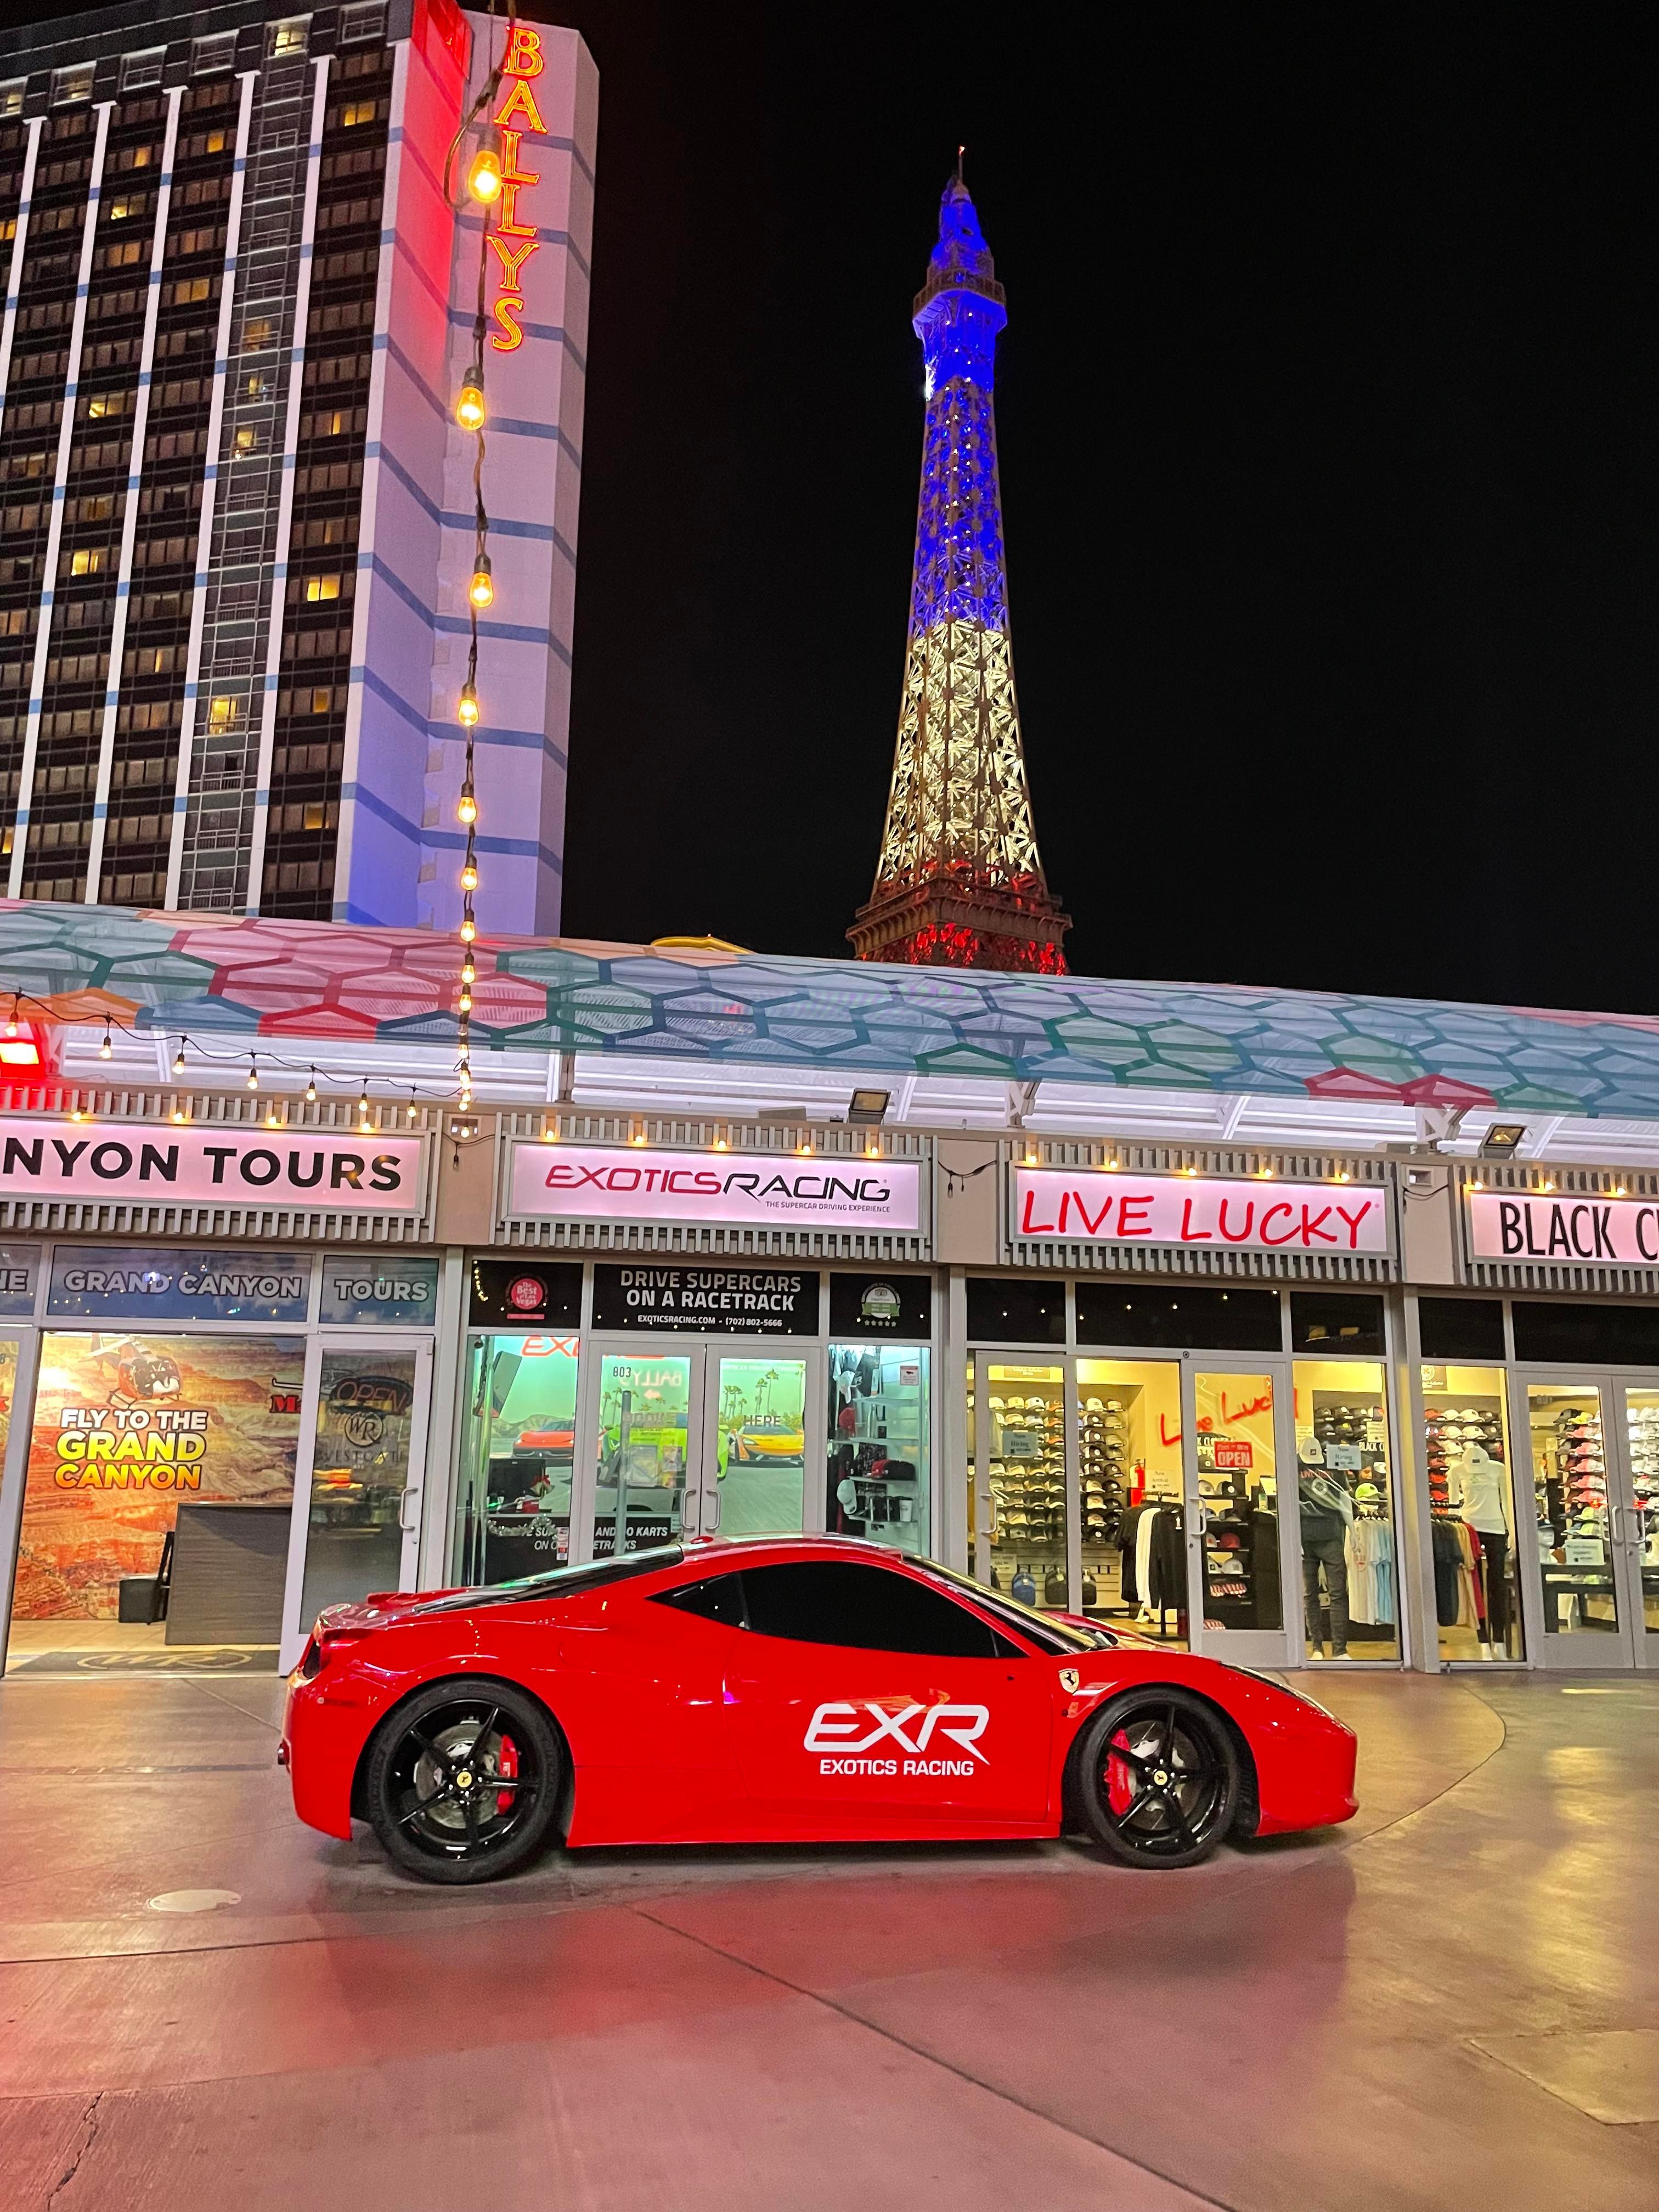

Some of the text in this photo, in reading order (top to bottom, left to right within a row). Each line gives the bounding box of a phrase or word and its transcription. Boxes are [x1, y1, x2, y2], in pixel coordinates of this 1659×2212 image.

[485, 26, 548, 351] BALLYS
[2, 1137, 402, 1191] NYON TOURS
[781, 1201, 817, 1210] SUPERCAR
[1022, 1190, 1372, 1249] LIVE LUCKY
[1499, 1201, 1659, 1261] BLACK C
[64, 1269, 170, 1294] GRAND
[178, 1273, 302, 1298] CANYON
[334, 1279, 430, 1302] TOURS
[517, 1285, 537, 1295] Best
[620, 1270, 802, 1292] DRIVE SUPERCARS
[516, 1297, 537, 1306] Vegas
[626, 1289, 794, 1311] ON A RACETRACK
[637, 1314, 715, 1325] EXOTICSRACING.COM
[725, 1317, 745, 1325] (702)
[613, 1366, 631, 1378] 803
[61, 1408, 208, 1430] FLY TO THE
[743, 1415, 781, 1427] HERE
[56, 1430, 206, 1462] GRAND
[1217, 1451, 1250, 1466] OPEN
[55, 1463, 201, 1490] CANYON
[636, 1527, 668, 1537] KARTS
[803, 1702, 990, 1766] EXR
[819, 1759, 974, 1776] EXOTICS RACING
